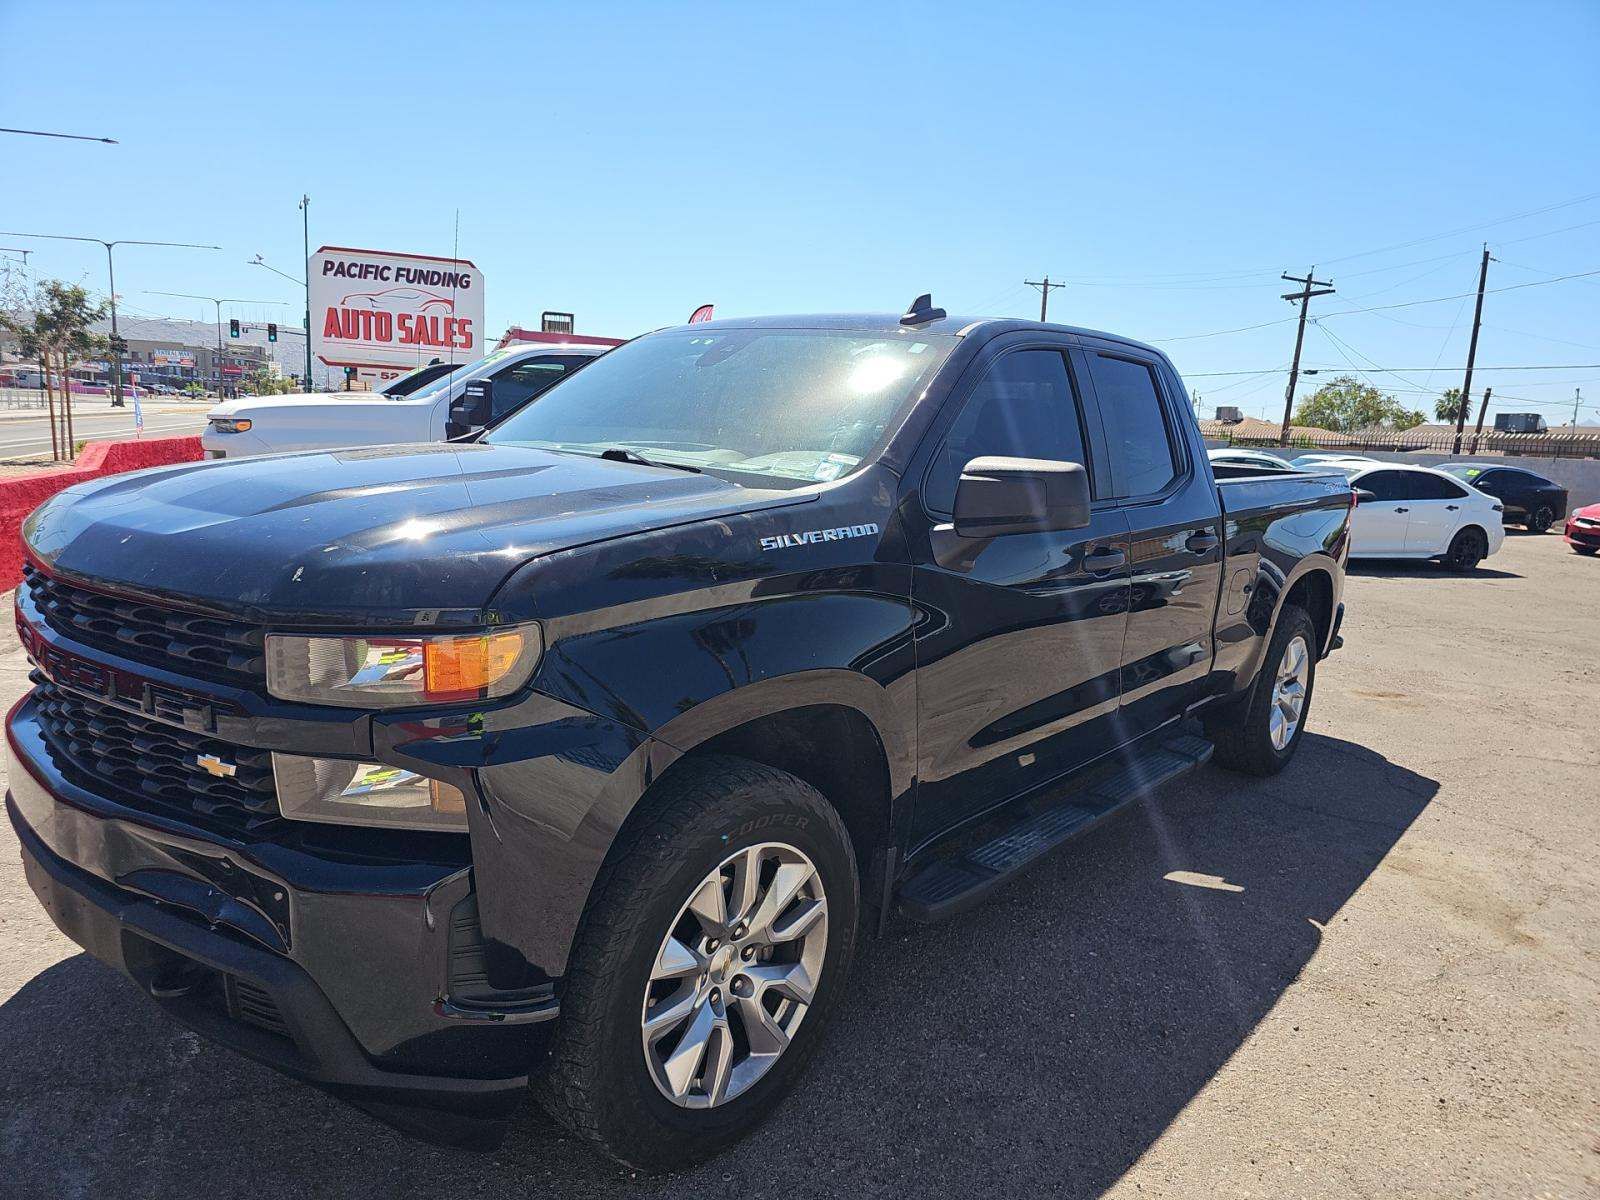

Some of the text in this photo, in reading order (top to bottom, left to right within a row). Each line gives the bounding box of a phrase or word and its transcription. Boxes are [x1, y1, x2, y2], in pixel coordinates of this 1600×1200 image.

[322, 260, 471, 289] PACIFIC FUNDING
[323, 307, 473, 349] AUTO SALES
[760, 523, 879, 551] SILVERADO
